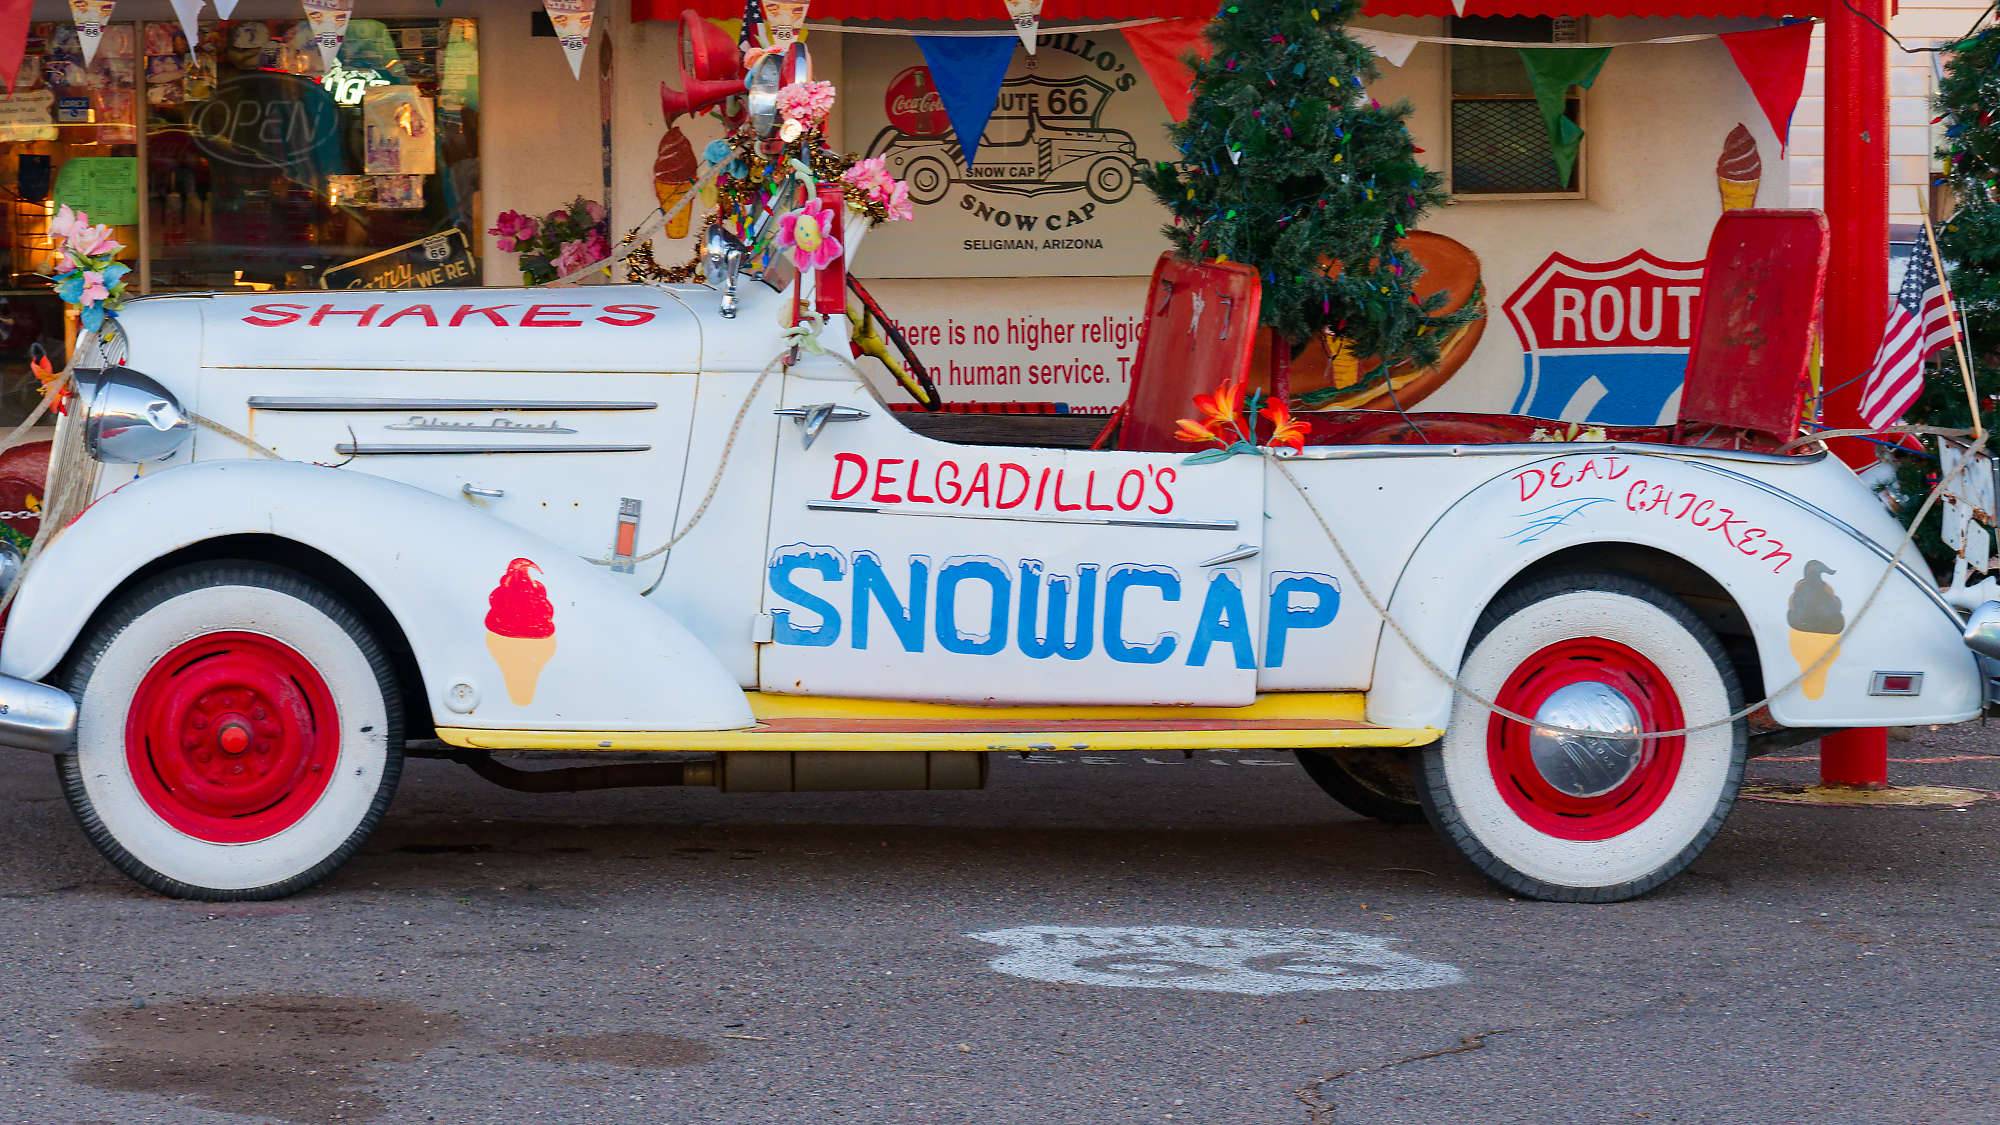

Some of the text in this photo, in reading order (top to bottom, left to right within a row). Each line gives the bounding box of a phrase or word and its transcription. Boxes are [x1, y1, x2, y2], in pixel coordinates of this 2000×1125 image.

[778, 31, 791, 39] 66
[1048, 88, 1088, 115] 66
[199, 100, 325, 143] OPEN
[965, 166, 1036, 178] SNOW CAP
[959, 193, 1097, 232] SNOW CAP
[431, 247, 446, 259] 66
[963, 238, 1104, 252] SELIGMAN, ARIZONA
[415, 260, 469, 288] WE'RE
[241, 303, 661, 328] SHAKES
[1553, 285, 1700, 342] ROUT
[948, 318, 966, 345] is
[973, 323, 1000, 345] no
[1007, 316, 1075, 351] higher
[1081, 315, 1144, 350] religio
[949, 358, 1021, 386] human
[1028, 357, 1110, 385] service.
[830, 452, 1177, 515] DELGADILLO'S
[768, 541, 1341, 670] SNOWCAP
